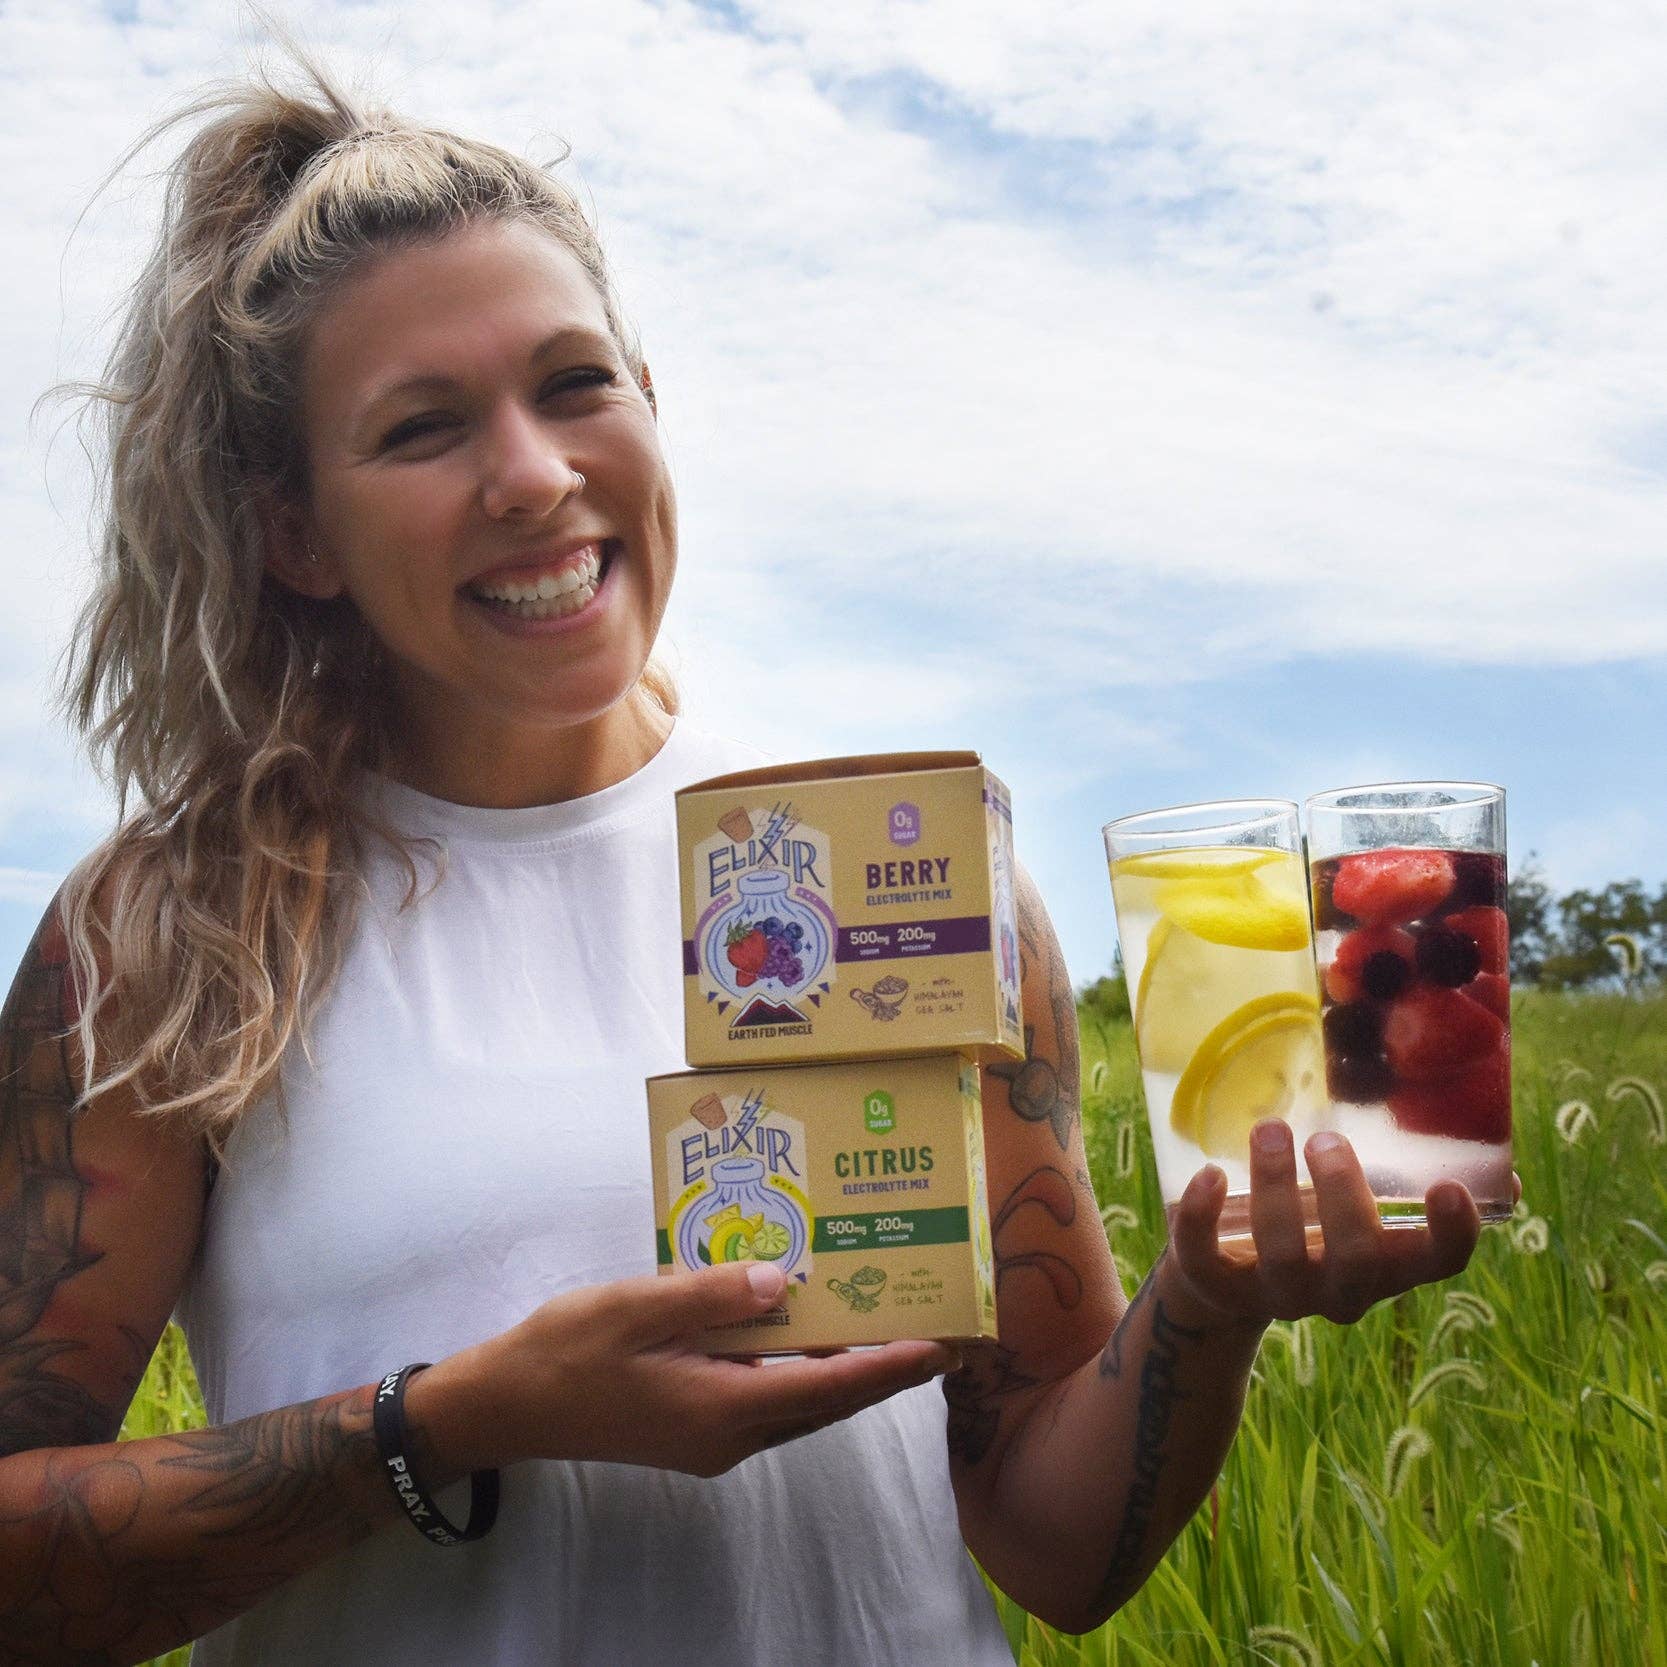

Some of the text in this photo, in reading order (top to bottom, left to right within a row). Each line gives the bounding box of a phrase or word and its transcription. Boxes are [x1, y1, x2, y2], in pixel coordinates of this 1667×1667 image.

[708, 838, 826, 898] ELIXIR
[866, 857, 951, 889] BERRY
[866, 889, 953, 906] ELECTROLYTE MIX
[850, 927, 936, 945] 500mg 200mg
[728, 1023, 813, 1041] EARTH FED MUSCLE
[681, 1125, 801, 1186] ELIXIR
[834, 1146, 934, 1178] CITRUS
[842, 1178, 930, 1195] ELECTROLYTE MIX
[826, 1216, 914, 1236] 500mg 200mg
[754, 1315, 790, 1328] MUSCLE
